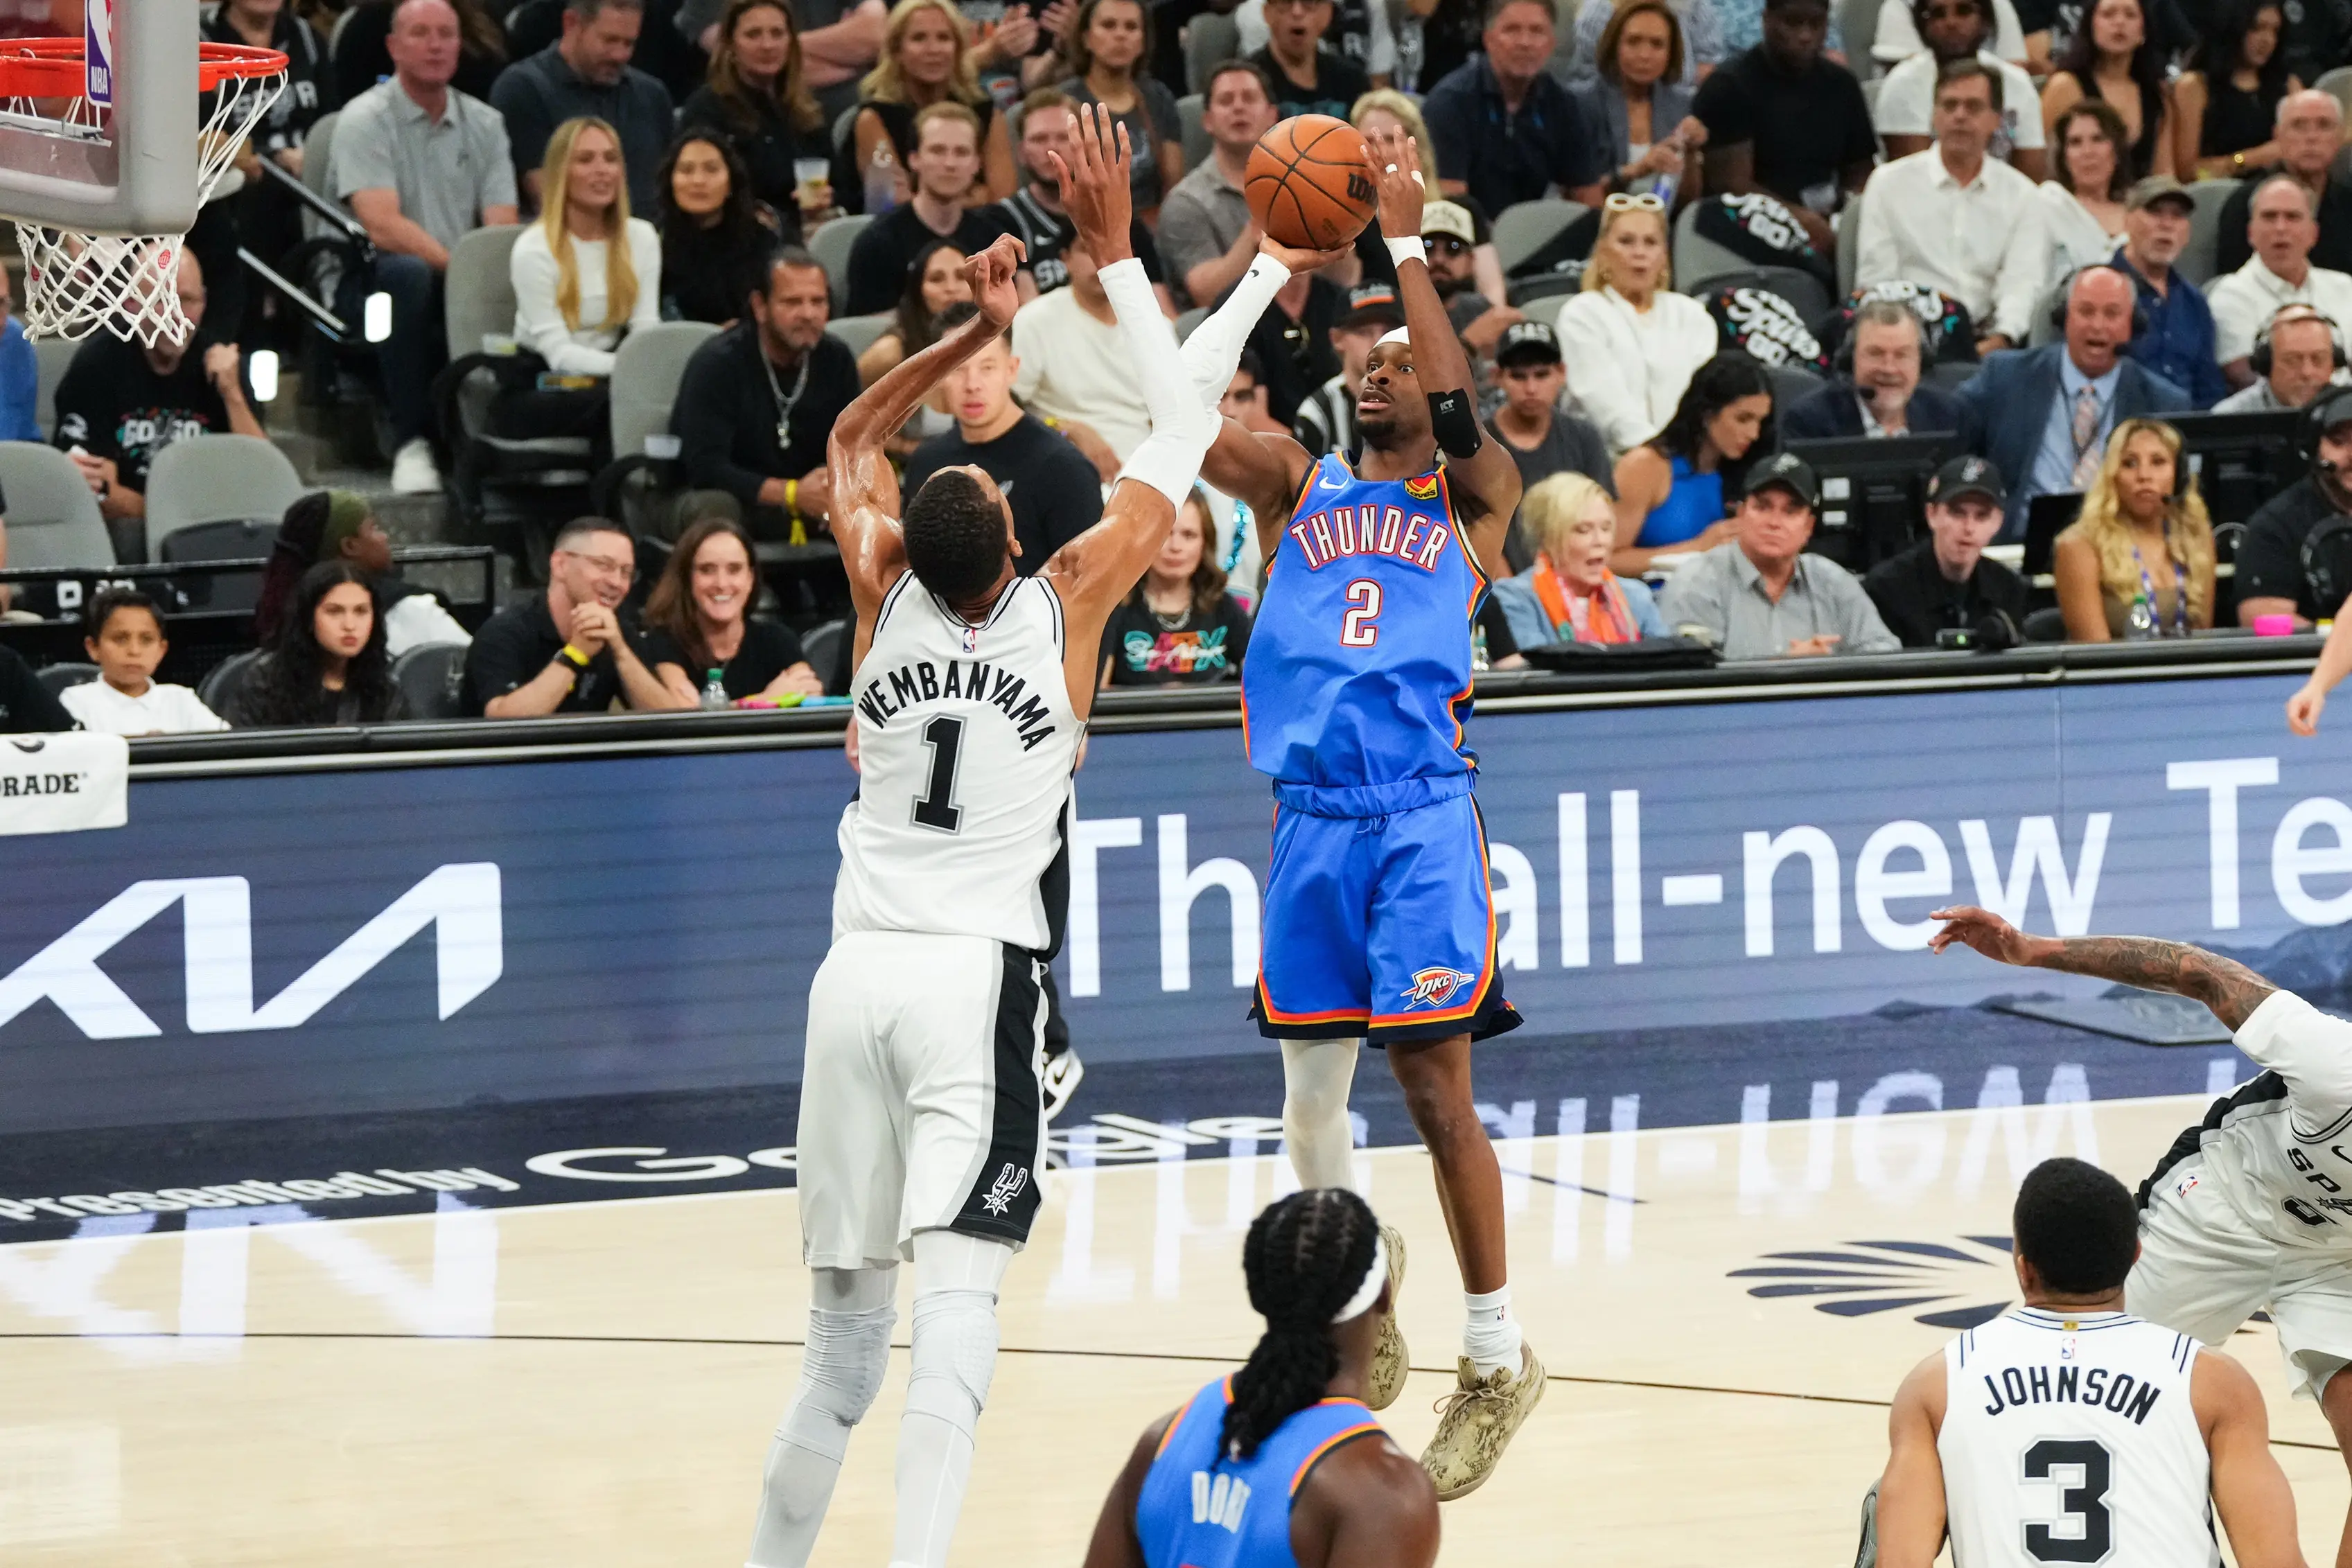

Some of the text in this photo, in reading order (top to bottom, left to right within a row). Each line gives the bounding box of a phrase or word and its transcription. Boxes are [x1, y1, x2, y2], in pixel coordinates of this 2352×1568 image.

[91, 66, 108, 95] NBA
[1290, 504, 1450, 573] THUNDER
[1340, 577, 1383, 648] 2
[858, 660, 1055, 752] WEMBANYAMA
[0, 773, 80, 797] RADE
[909, 712, 968, 836] 1
[1069, 813, 1261, 998] Th
[1414, 974, 1451, 1001] OKC
[374, 1168, 520, 1192] by
[1984, 1365, 2161, 1425] JOHNSON
[2018, 1434, 2118, 1568] 3
